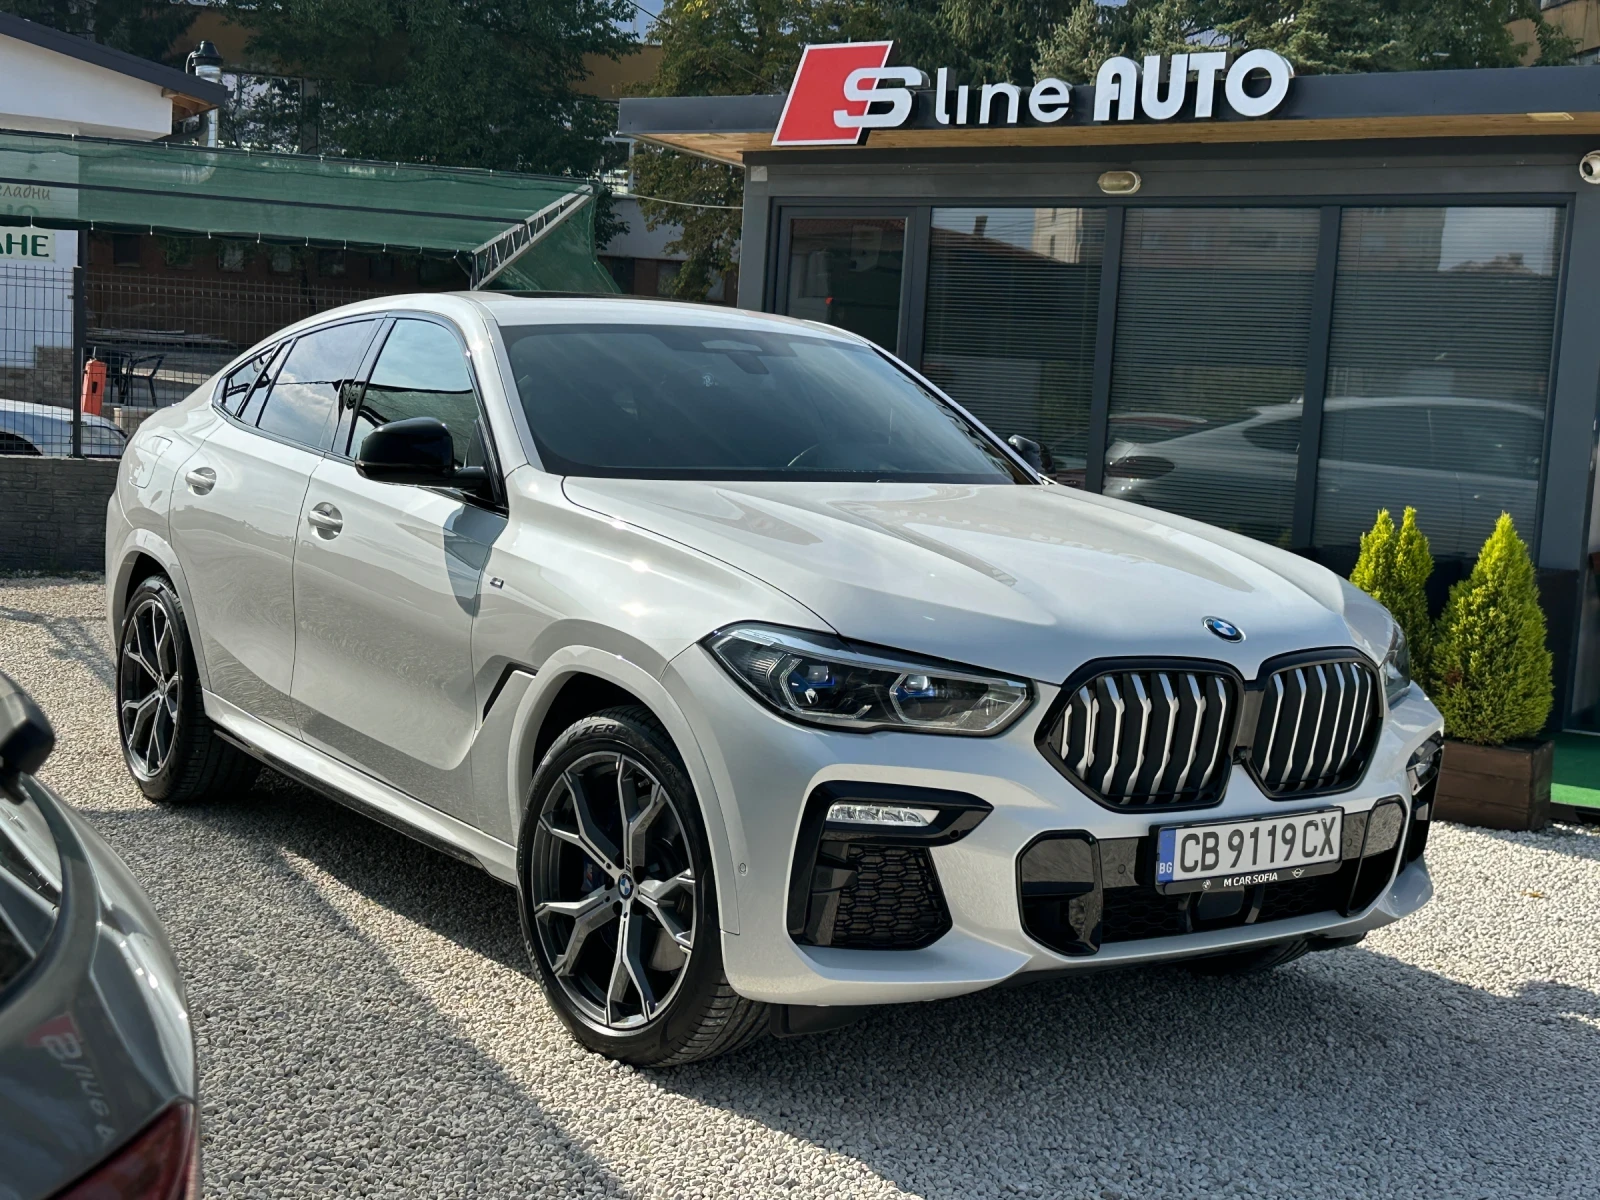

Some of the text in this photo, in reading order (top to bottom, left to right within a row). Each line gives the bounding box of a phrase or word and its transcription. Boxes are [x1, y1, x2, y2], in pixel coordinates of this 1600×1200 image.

[833, 49, 1290, 128] S line AUTO
[0, 233, 50, 258] НЕ
[1159, 862, 1173, 874] BG
[1223, 872, 1278, 888] M CAR SOFIA
